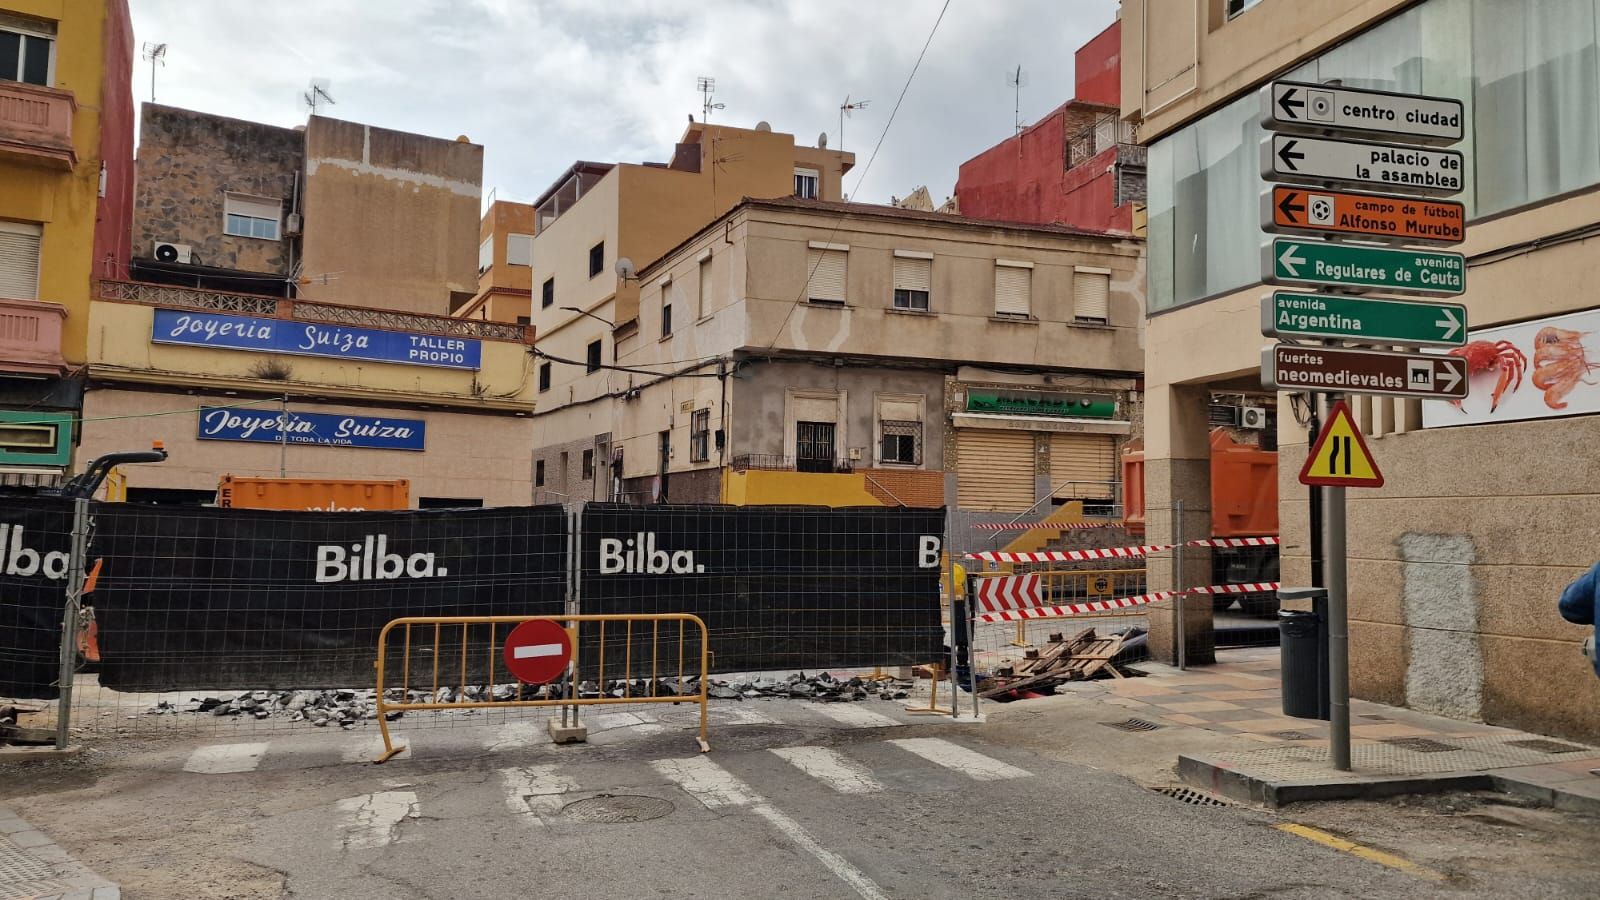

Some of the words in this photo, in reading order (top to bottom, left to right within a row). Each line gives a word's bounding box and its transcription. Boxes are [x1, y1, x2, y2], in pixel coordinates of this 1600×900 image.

[1342, 104, 1395, 121] centro
[1406, 109, 1459, 128] ciudad
[1371, 150, 1429, 166] palacio
[1440, 155, 1458, 170] de
[1356, 164, 1370, 179] la
[1381, 169, 1458, 188] asamblea
[1355, 201, 1395, 214] campo
[1402, 204, 1416, 215] de
[1424, 206, 1460, 219] fútbol
[1340, 214, 1397, 232] Alfonso
[1406, 219, 1460, 237] Murube
[1315, 260, 1386, 281] Regulares
[1395, 267, 1412, 282] de
[1420, 269, 1460, 286] Ceuta
[1415, 257, 1460, 270] avenida
[1278, 299, 1326, 311] avenida
[1278, 310, 1362, 330] Argentina
[299, 325, 369, 352] Suiza
[409, 335, 465, 351] TALLER
[409, 349, 464, 364] PROPIO
[1278, 351, 1324, 365] fuertes
[1278, 369, 1403, 388] neomedievales
[334, 418, 414, 439] Suiza
[318, 437, 330, 445] LA
[315, 533, 448, 583] Bilba.
[599, 531, 705, 575] Bilba.
[918, 535, 941, 569] B
